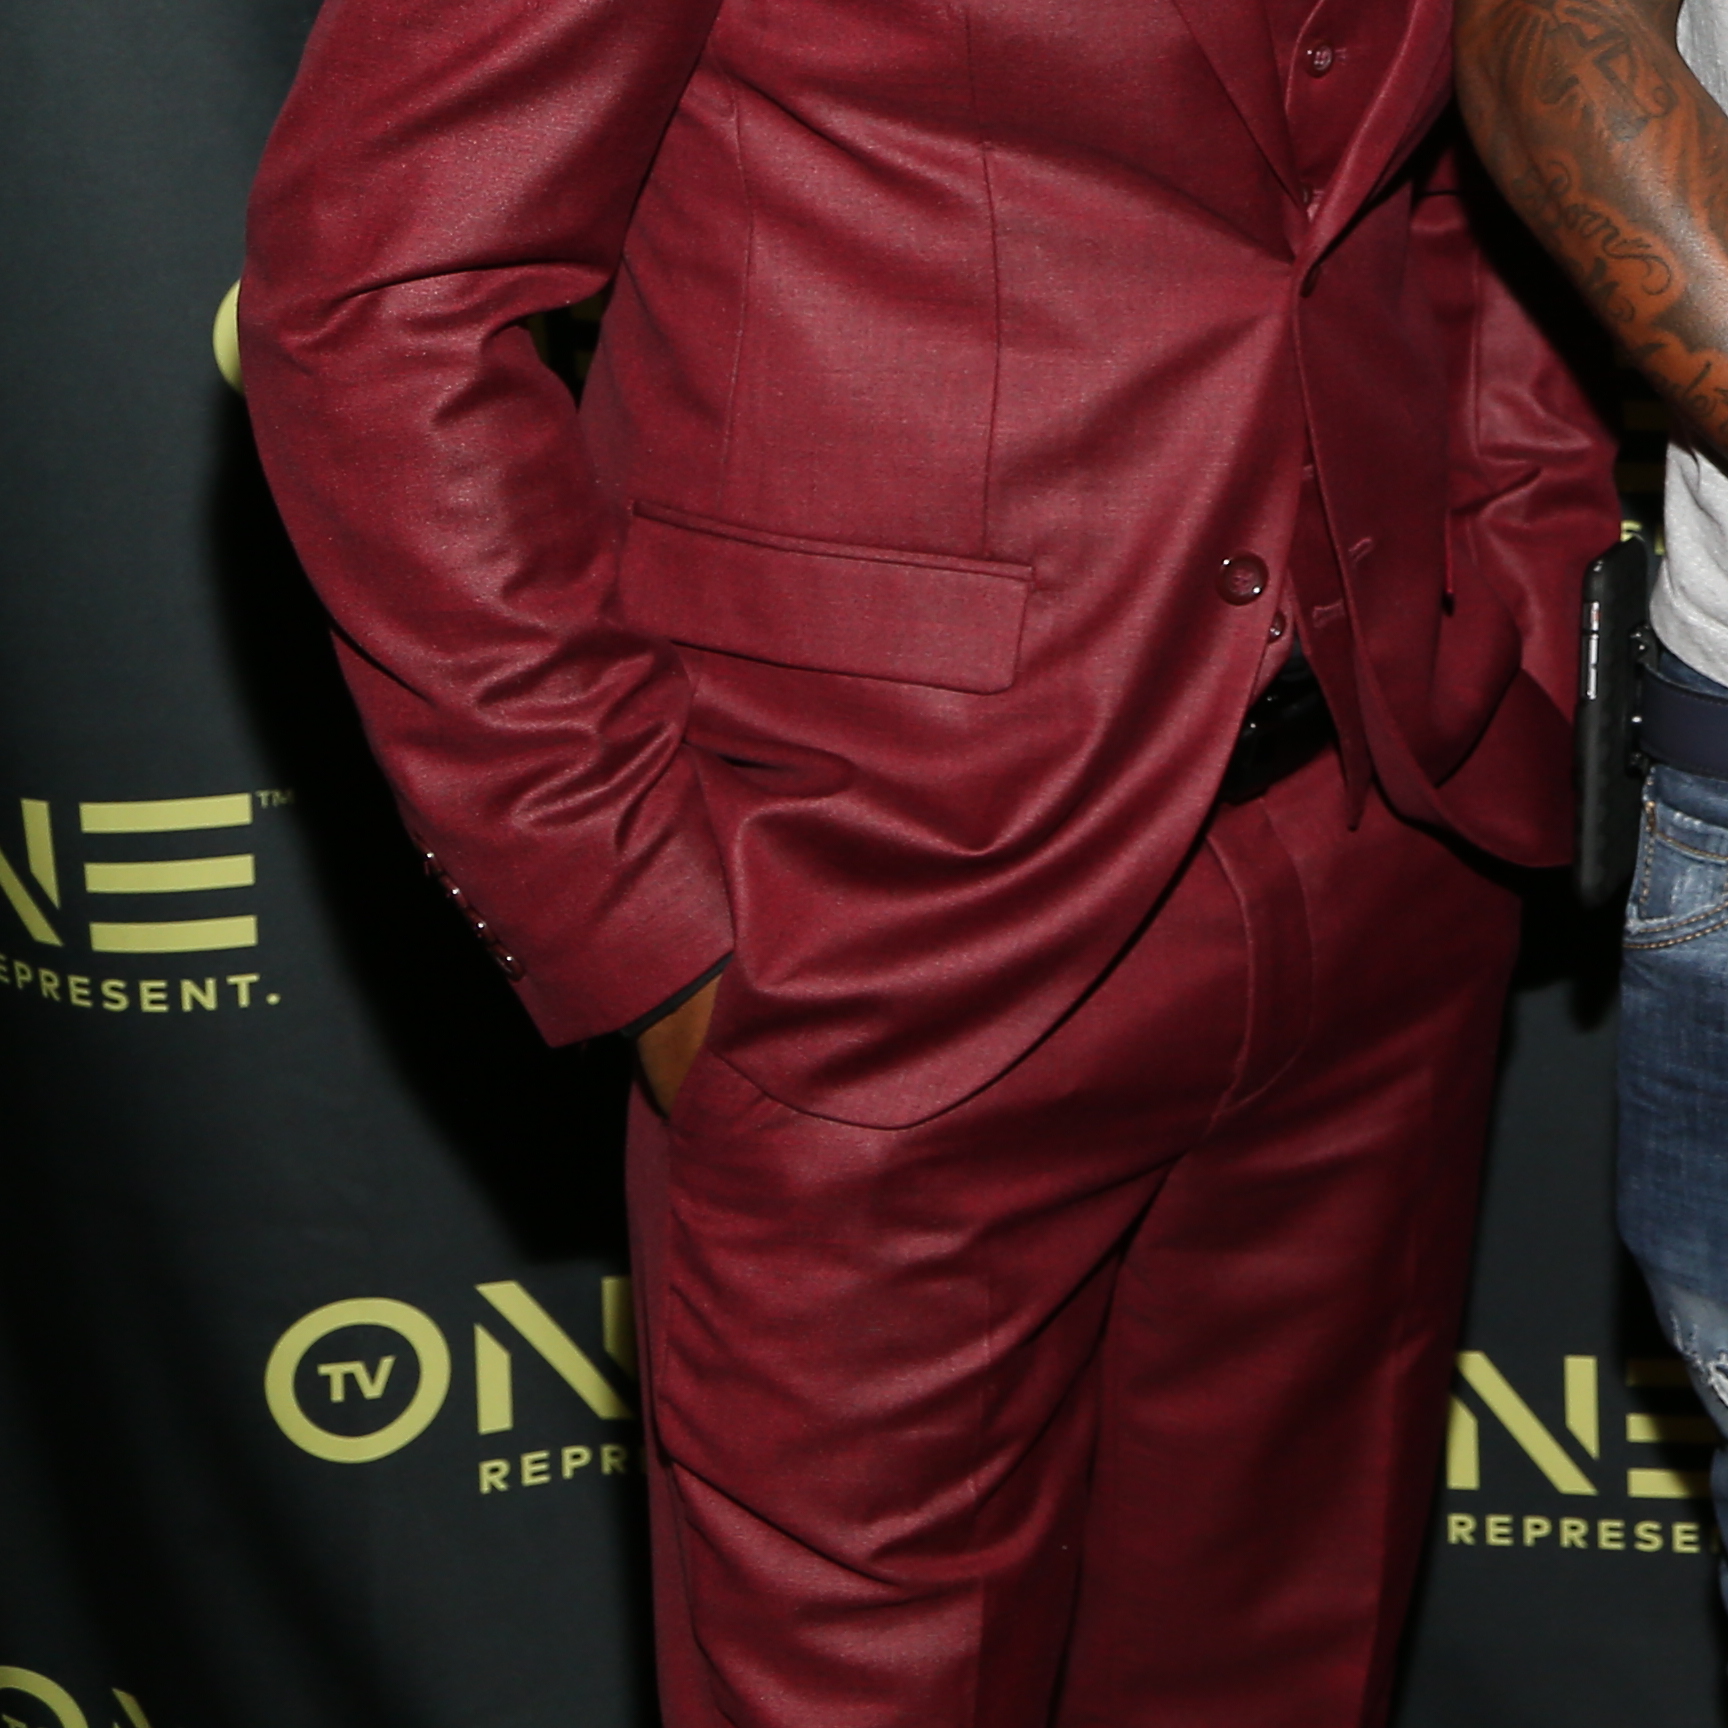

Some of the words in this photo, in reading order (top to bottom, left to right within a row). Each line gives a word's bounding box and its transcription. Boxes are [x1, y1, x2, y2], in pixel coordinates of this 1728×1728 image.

[0, 792, 258, 953] NE
[0, 952, 281, 1014] EPRESENT.
[264, 1276, 634, 1464] ON
[317, 1355, 395, 1403] TV
[1446, 1350, 1712, 1499] NE
[1447, 1513, 1700, 1554] REPRESE
